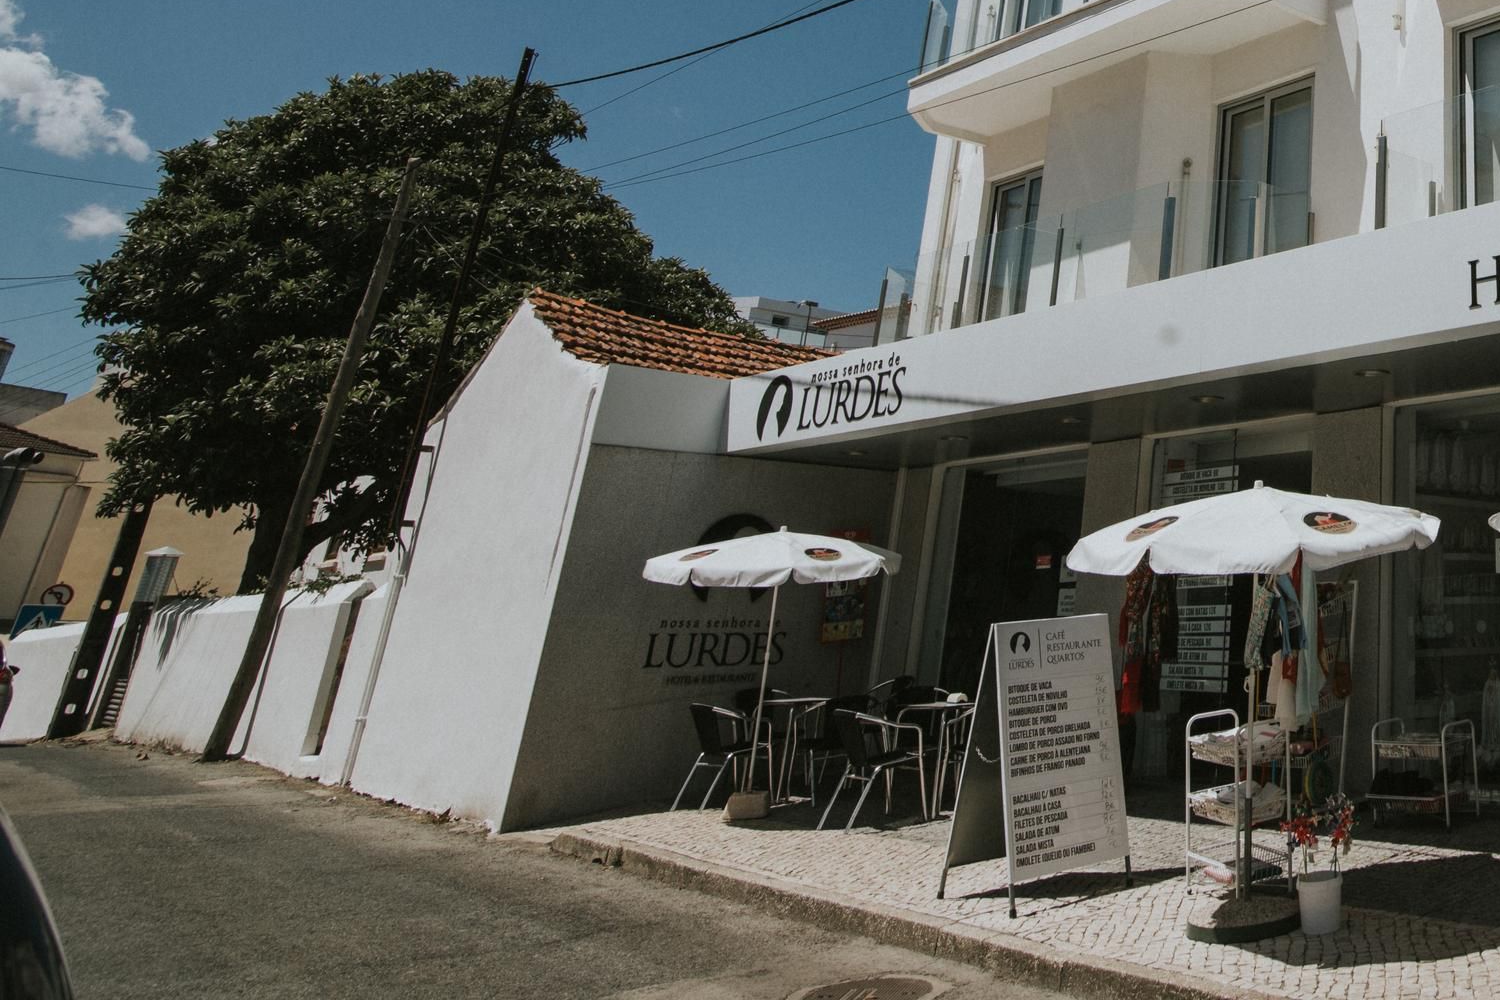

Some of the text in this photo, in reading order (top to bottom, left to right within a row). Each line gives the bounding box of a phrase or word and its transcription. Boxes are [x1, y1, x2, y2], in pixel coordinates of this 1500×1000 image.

[811, 352, 901, 384] nossa senhora de
[797, 367, 907, 431] LURDES
[660, 619, 701, 629] nossa
[707, 616, 761, 629] senhora
[1045, 629, 1065, 641] CAFÉ
[642, 632, 787, 669] LURDES
[1046, 639, 1102, 652] RESTAURANTE
[1008, 660, 1035, 670] LURDES
[1047, 652, 1085, 665] QUARTOS
[1008, 683, 1030, 694] BITOQUE
[1031, 682, 1038, 691] DE
[1039, 681, 1052, 690] VACA
[1008, 694, 1037, 705] COSTELETA
[1038, 693, 1045, 702] DE
[1046, 690, 1068, 700] NOVILHO
[1008, 704, 1044, 717] HAMBURGUER
[1045, 703, 1057, 713] COM
[1009, 715, 1057, 729] BITOQUE DE PORCO
[1009, 729, 1039, 740] COSTELETA
[1039, 727, 1046, 736] DE
[1047, 725, 1064, 735] PORCO
[1065, 721, 1091, 733] GRELHADA
[1009, 731, 1100, 753] LOMBO DE PORCO ASSADO NO FORNO
[1010, 755, 1028, 766] CARNE
[1030, 753, 1036, 763] DE
[1037, 751, 1054, 762] PORCO
[1060, 745, 1091, 758] ALENTEJANA
[1011, 757, 1085, 778] BIFINHOS DE FRANGO PANADO
[1012, 792, 1041, 805] BACALHAU
[1041, 790, 1049, 800] C/
[1050, 786, 1066, 797] NATAS
[1013, 805, 1042, 818] BACALHAU
[1047, 800, 1062, 810] CASA
[1014, 817, 1035, 830] FILETES
[1036, 815, 1043, 825] DE
[1044, 811, 1068, 823] PESCADA
[1015, 830, 1036, 842] SALADA
[1037, 828, 1044, 837] DE
[1045, 825, 1060, 835] ATUM
[1016, 843, 1037, 855] SALADA
[1037, 839, 1054, 850] MISTA
[1063, 849, 1070, 858] OU
[1071, 842, 1096, 857] FIAMBRE)
